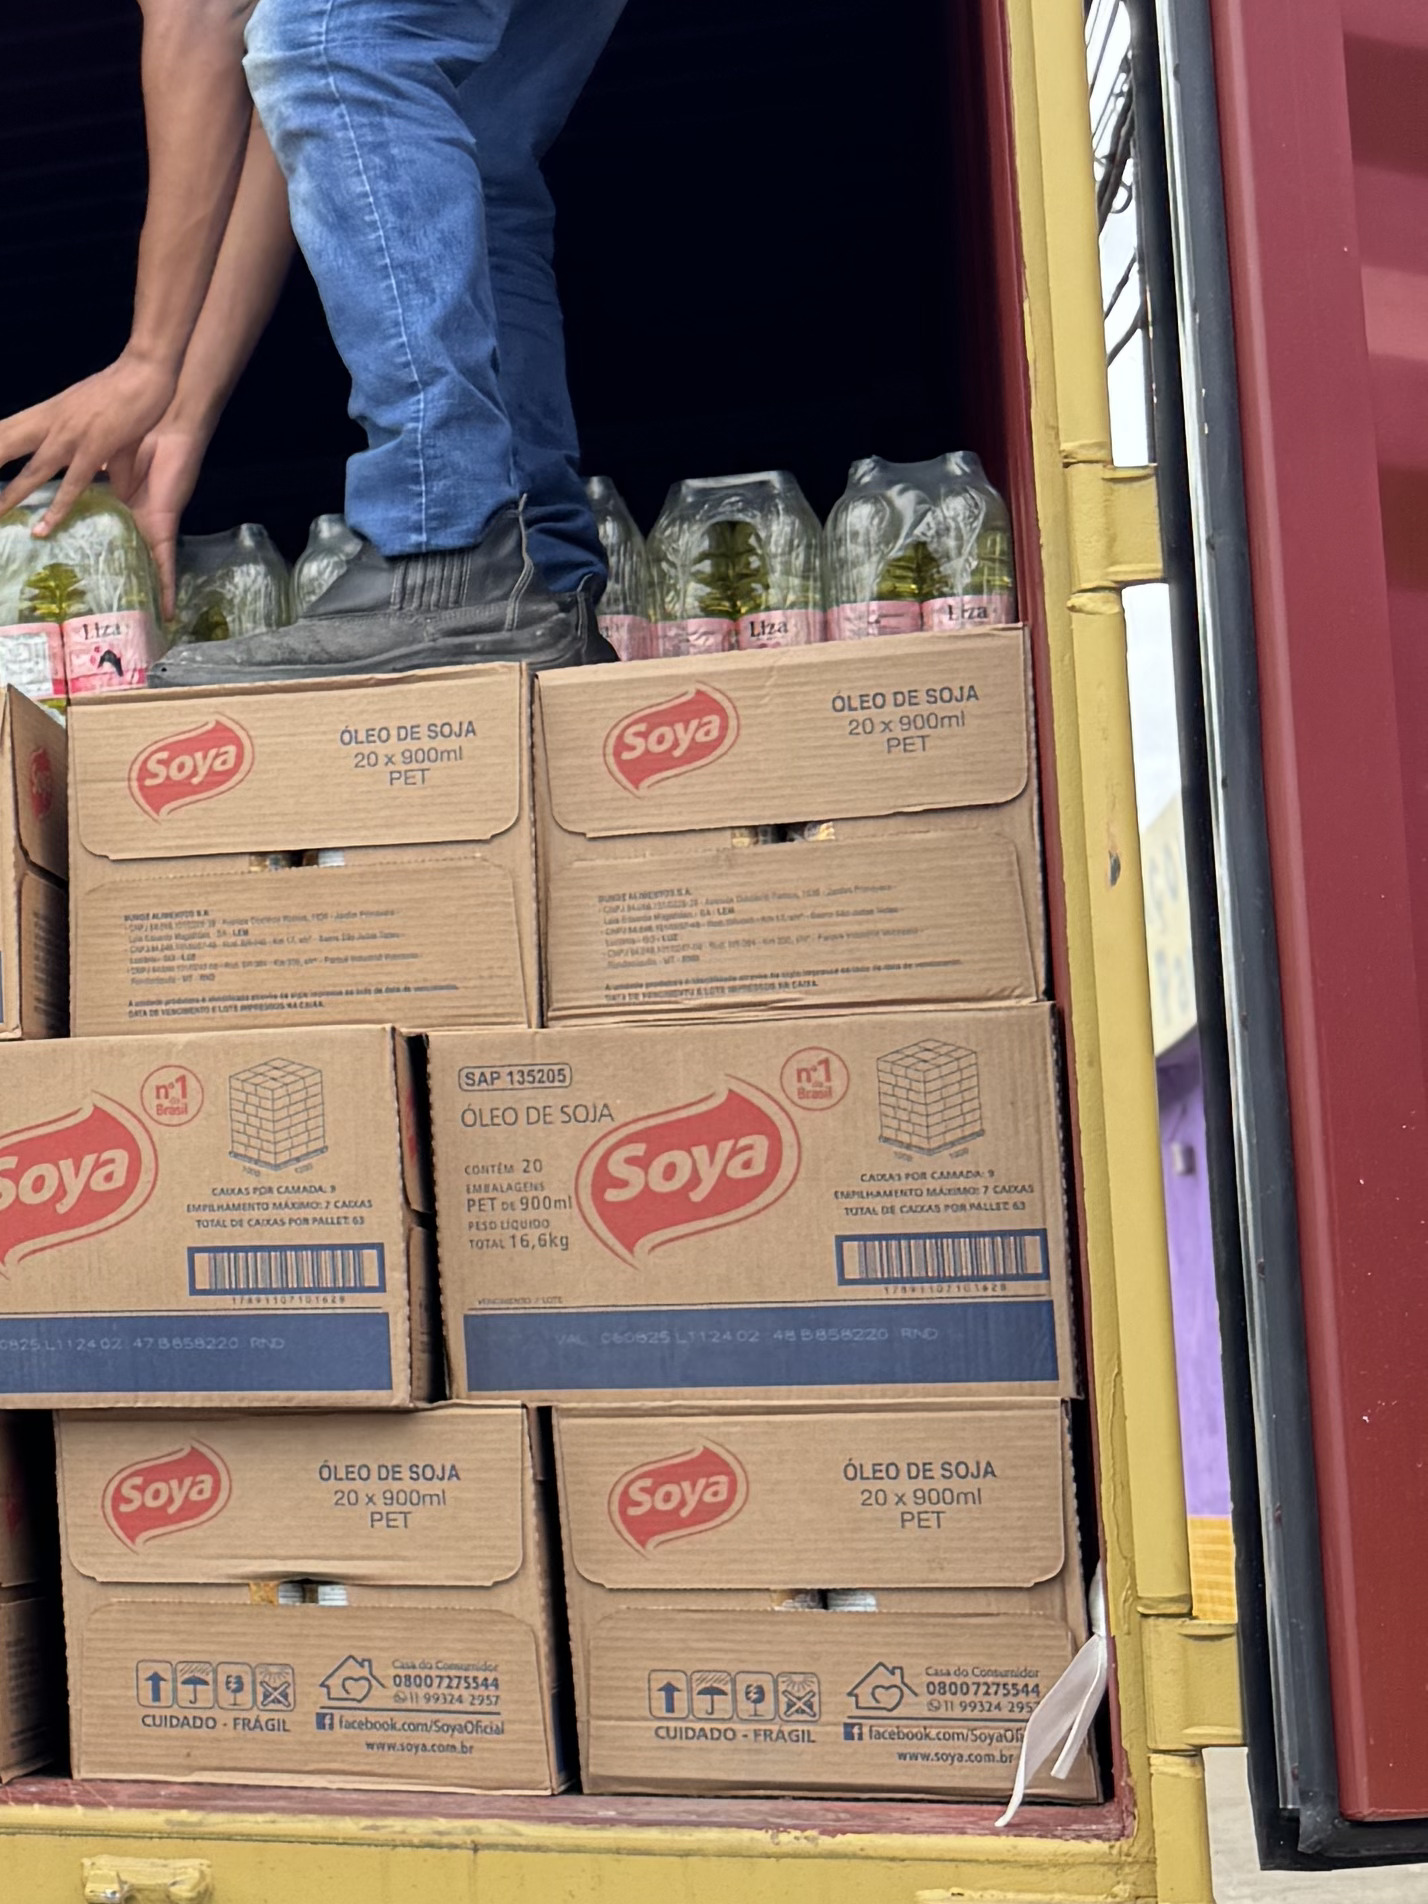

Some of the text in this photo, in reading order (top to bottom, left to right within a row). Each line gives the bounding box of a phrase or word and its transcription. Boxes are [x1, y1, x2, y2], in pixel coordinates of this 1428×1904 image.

[832, 686, 979, 712] ÓLEO DE SOJA
[848, 712, 965, 735] 20 x 900ml
[340, 720, 476, 746] ÓLEO DE SOJA
[621, 715, 719, 760] Soya
[887, 735, 930, 753] PET
[145, 744, 236, 786] Soya
[354, 746, 462, 768] 20 x 900ml
[390, 769, 429, 785] PET
[465, 1068, 566, 1086] SAP 135205
[462, 1103, 614, 1127] ÓLEO DE SOJA
[522, 1159, 542, 1173] 20
[604, 1133, 768, 1203] Soya
[467, 1195, 572, 1212] PET 900ml
[509, 1233, 569, 1251] 16,6kg
[319, 1460, 461, 1481] ÓLEO DE SOJA
[843, 1459, 997, 1481] ÓLEO DE SOJA
[118, 1474, 213, 1515] Soya
[334, 1490, 446, 1506] 20 x 900ml
[627, 1474, 728, 1517] Soya
[860, 1488, 981, 1506] 20 x 900ml
[370, 1513, 411, 1529] PET
[900, 1511, 945, 1528] PET
[393, 1675, 499, 1689] 08007275544
[926, 1681, 1040, 1697] 08007275544
[960, 1700, 1001, 1713] 99324
[142, 1714, 290, 1733] CUIDADO FRÁGIL
[339, 1715, 504, 1737] facebook.com/SoyaOficial
[655, 1723, 815, 1743] CUIDADO FRÁGIL
[366, 1740, 473, 1755] www.soya.com.br
[897, 1750, 1013, 1765] www.soya.com.br
